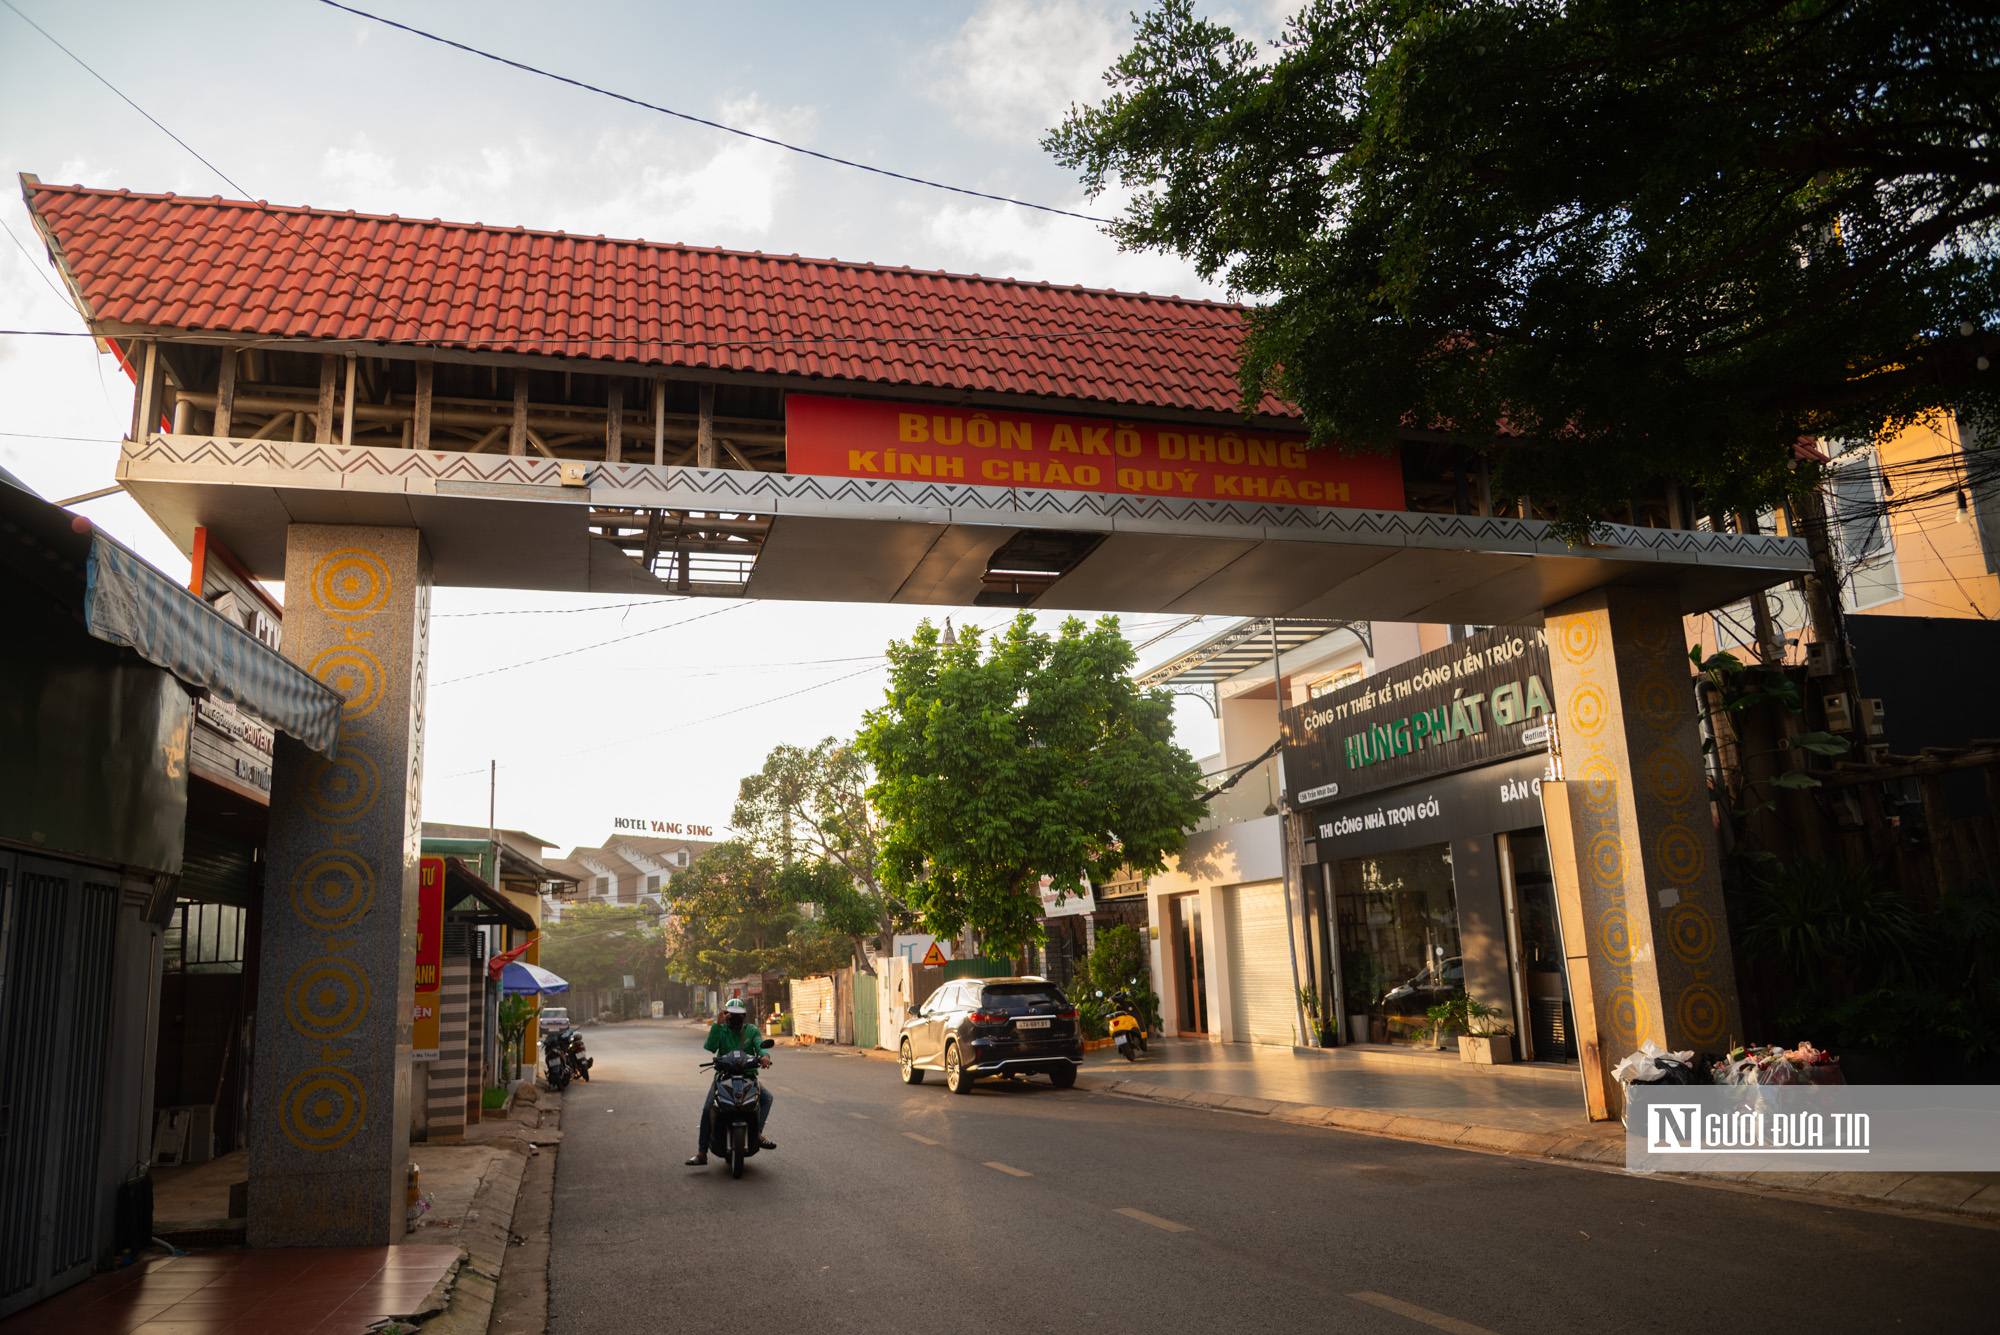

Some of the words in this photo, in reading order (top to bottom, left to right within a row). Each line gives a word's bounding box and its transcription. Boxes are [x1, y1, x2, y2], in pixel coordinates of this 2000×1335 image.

[898, 412, 1033, 451] BUÔN
[1157, 430, 1307, 470] DHÔNG
[848, 447, 965, 478] KÍNH
[981, 458, 1101, 487] CHÀO
[1117, 468, 1199, 493] QUÝ
[1213, 475, 1350, 502] KHÁCH
[1303, 709, 1334, 731] CÔNG
[1336, 703, 1349, 720] TY
[1350, 685, 1376, 715] THIẾT
[1378, 677, 1393, 705] KẾ
[1393, 681, 1412, 702] THI
[1412, 664, 1452, 692] CÔNG
[1453, 646, 1483, 678] KIẾN
[1485, 635, 1525, 666] TRÚC
[1344, 717, 1413, 771] HƯNG
[1412, 687, 1486, 751] PHÁT
[1491, 674, 1553, 727] GIA
[1319, 823, 1333, 839] THI
[1334, 816, 1363, 837] CÔNG
[1364, 807, 1386, 830] NHÀ
[1387, 804, 1415, 827] TRỌN
[1417, 795, 1440, 820] GÓI
[1500, 777, 1529, 803] BÀN
[614, 817, 647, 831] HOTEL
[651, 821, 683, 835] YANG
[686, 824, 713, 837] SING
